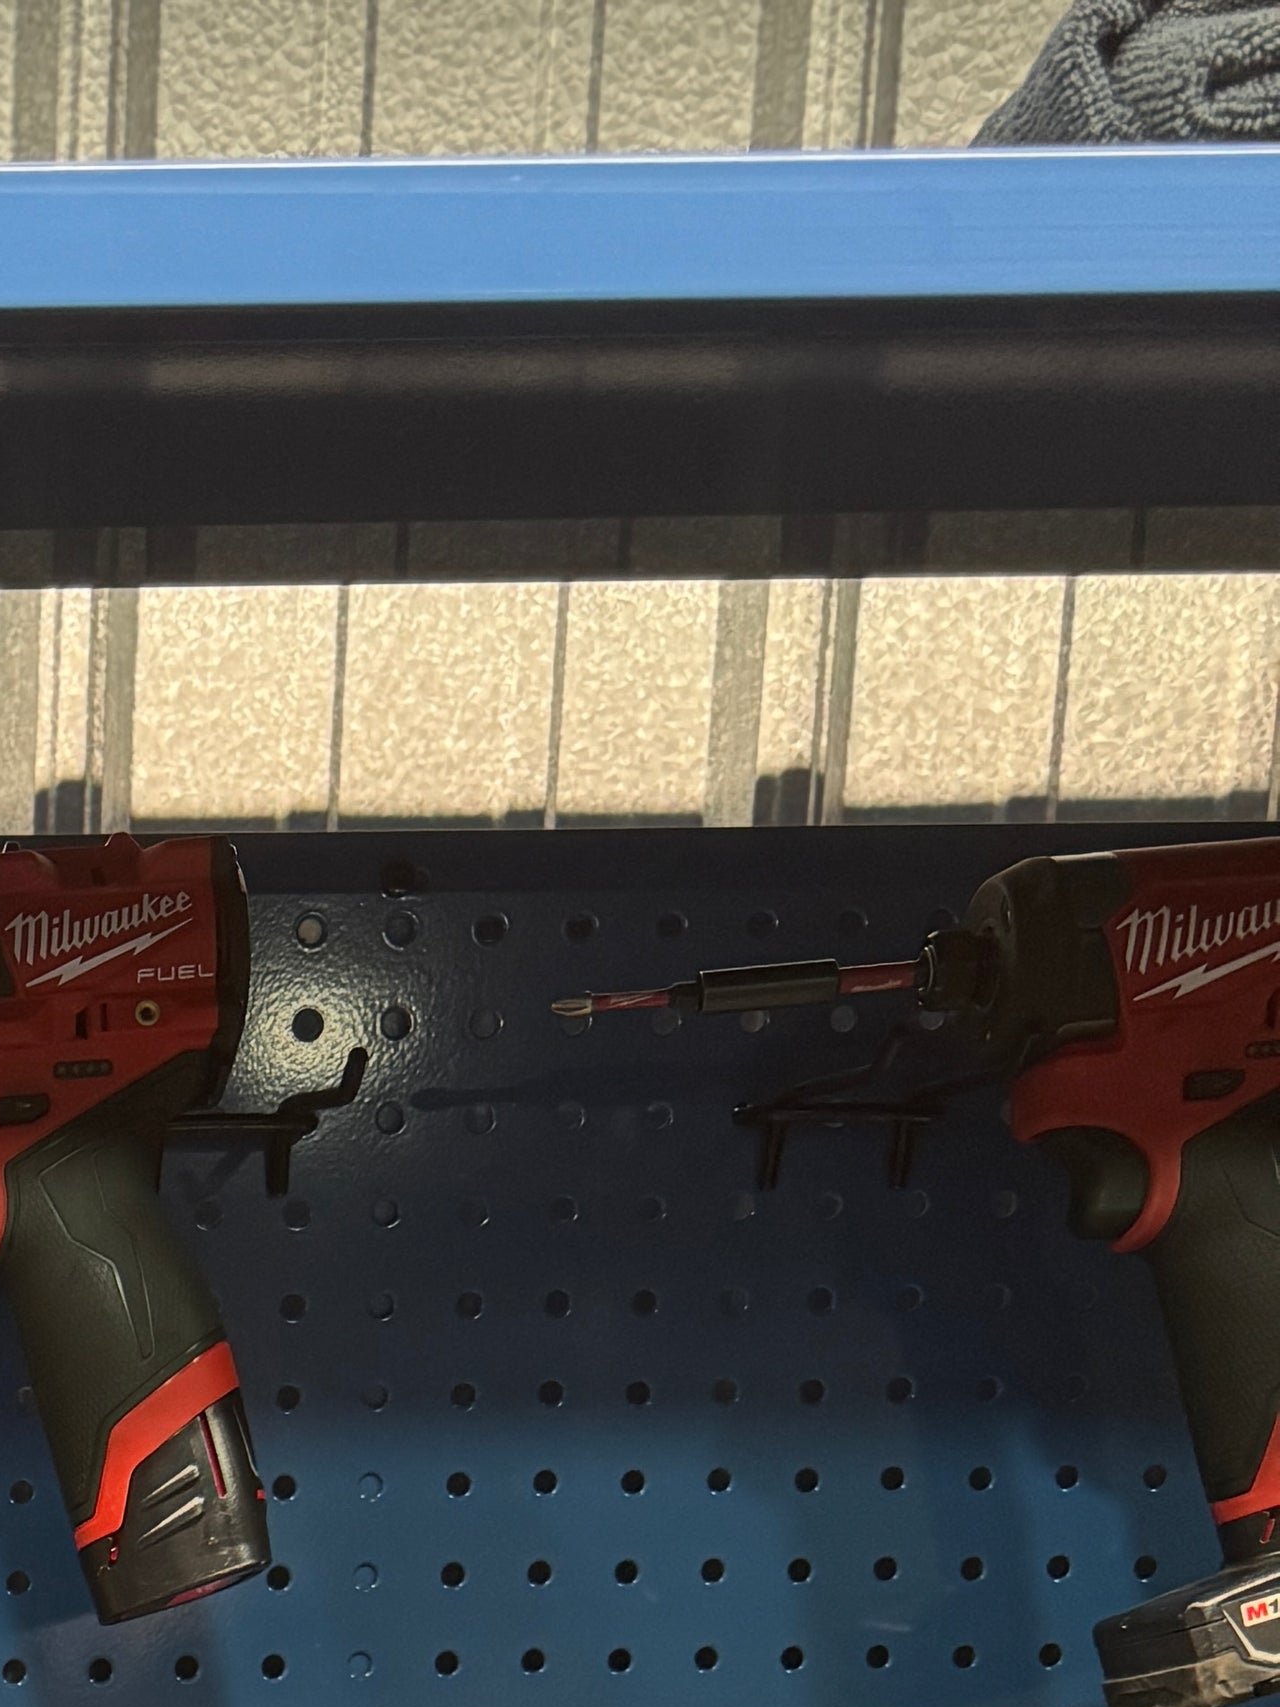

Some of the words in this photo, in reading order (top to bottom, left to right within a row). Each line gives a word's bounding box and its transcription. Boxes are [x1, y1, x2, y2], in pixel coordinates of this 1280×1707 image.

[4, 890, 193, 967] Milwaukee
[1116, 898, 1280, 976] Milwau
[136, 963, 215, 984] FUEL
